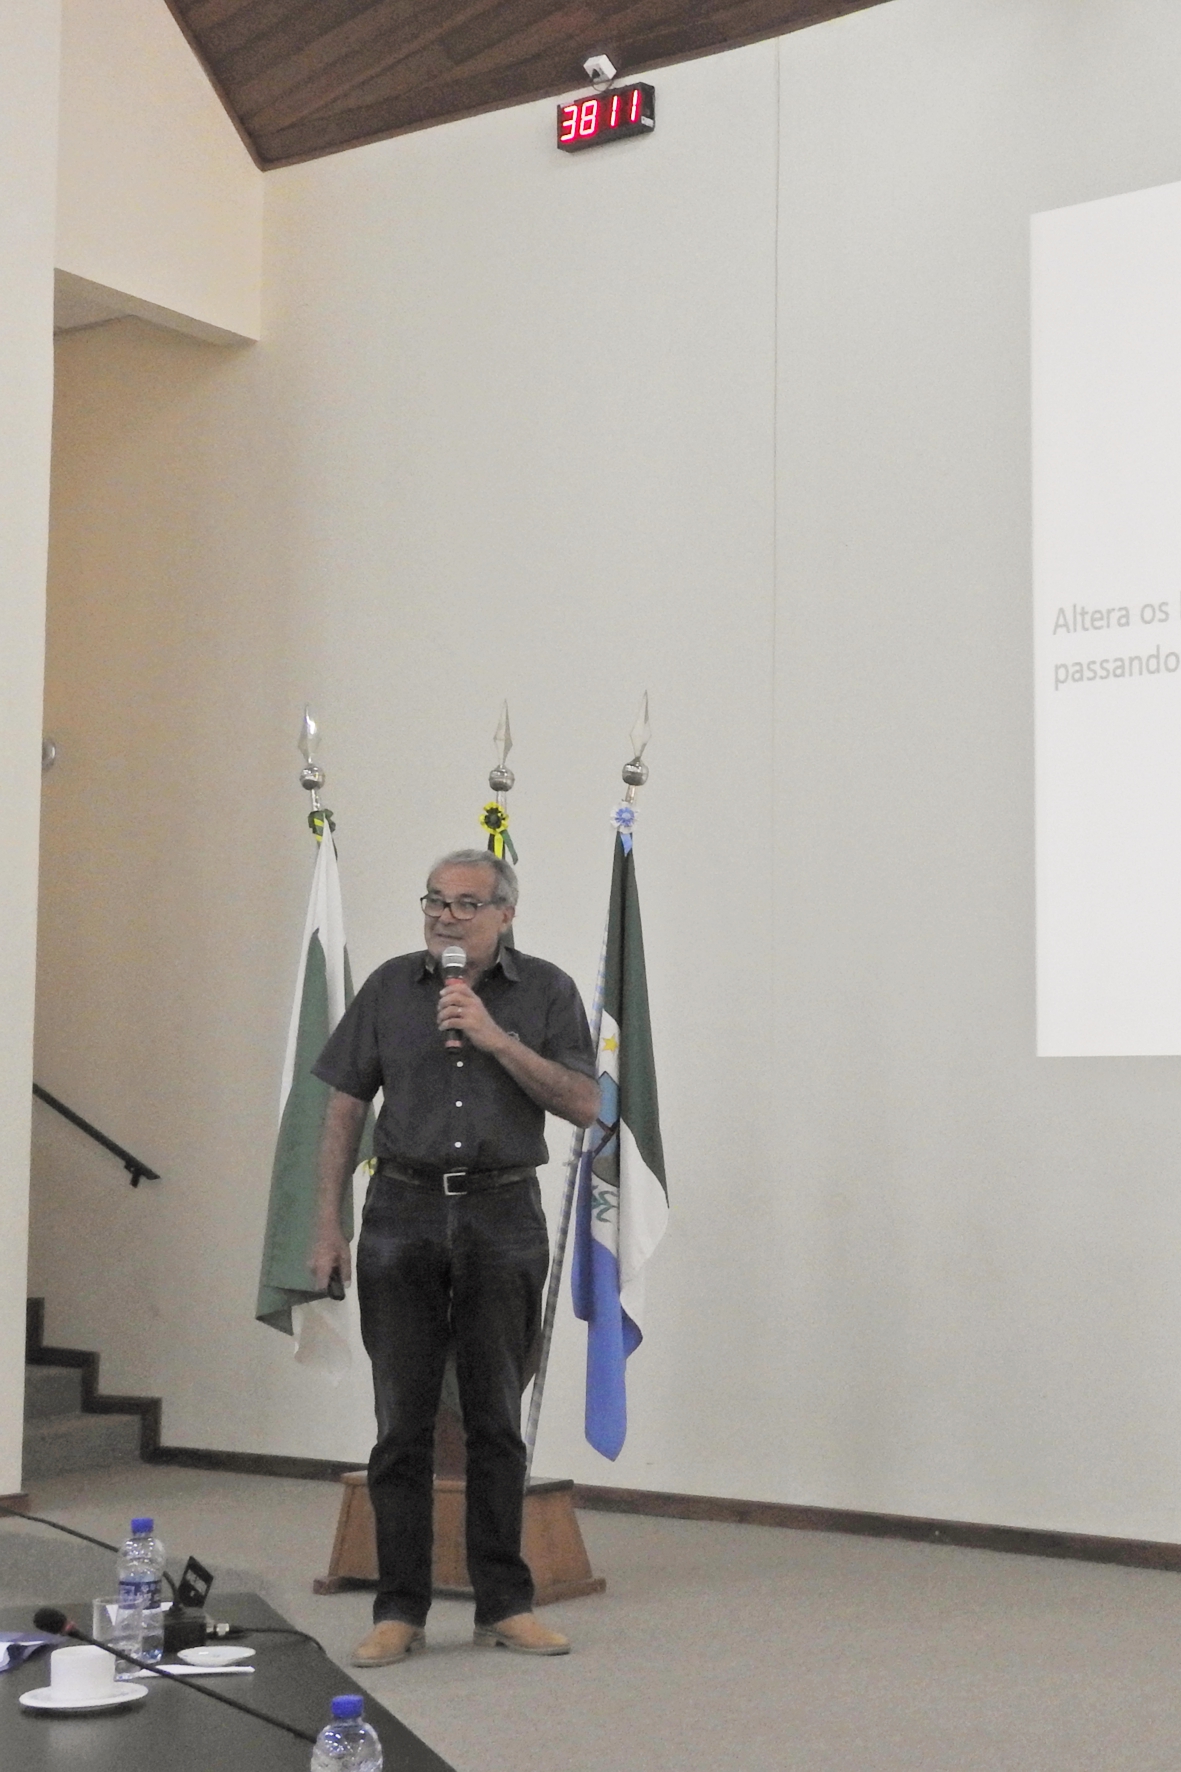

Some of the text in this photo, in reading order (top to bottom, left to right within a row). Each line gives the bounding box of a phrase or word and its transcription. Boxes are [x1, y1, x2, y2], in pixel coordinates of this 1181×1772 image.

[560, 88, 641, 142] 3811
[1052, 603, 1131, 635] Altera
[1139, 599, 1170, 625] os
[1053, 644, 1181, 691] passando
